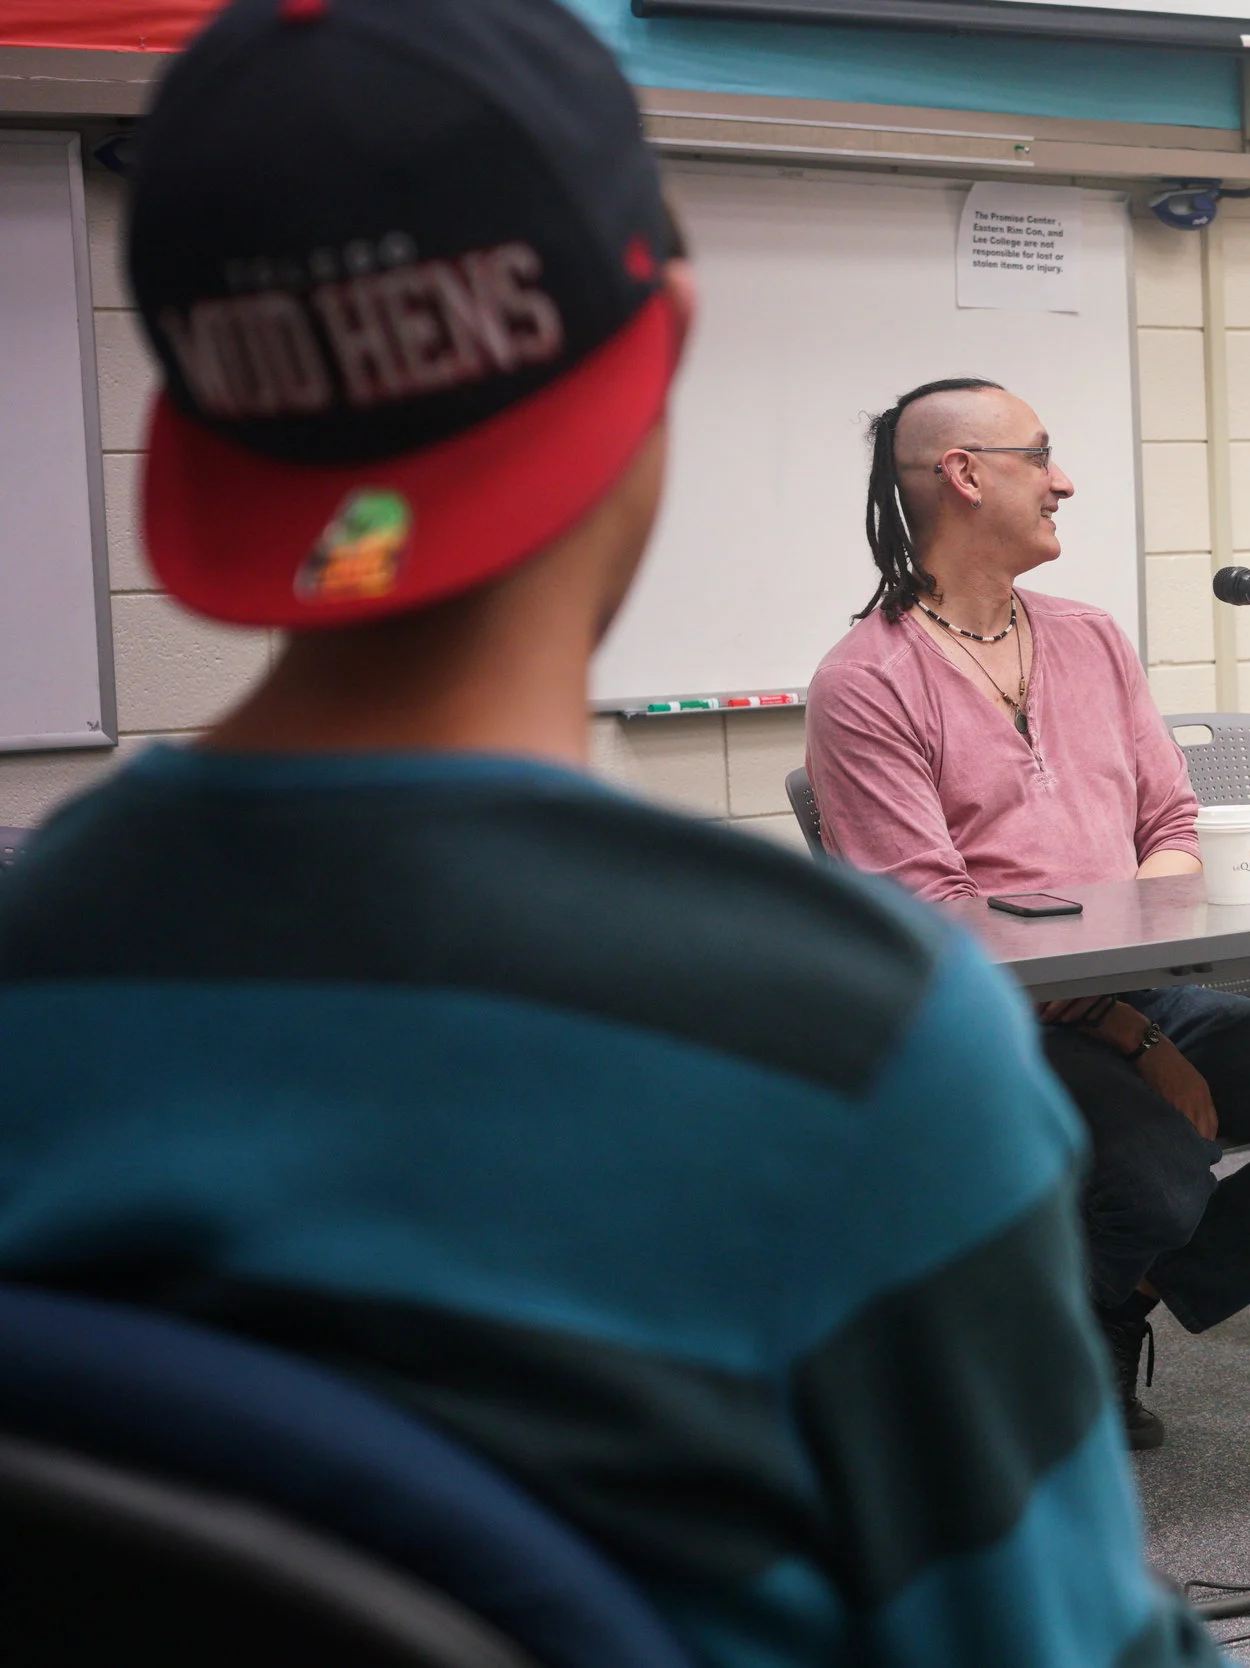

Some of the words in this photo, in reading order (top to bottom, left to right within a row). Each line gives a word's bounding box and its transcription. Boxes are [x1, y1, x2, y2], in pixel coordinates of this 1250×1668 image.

[975, 211, 989, 220] The
[991, 212, 1024, 223] Promise
[1027, 216, 1056, 225] Center
[973, 223, 1005, 233] Eastern
[1007, 226, 1023, 235] Rim
[1025, 228, 1045, 237] Con,
[1047, 230, 1063, 238] and
[973, 235, 987, 244] Lee
[990, 236, 1021, 248] College
[1040, 240, 1055, 248] not
[972, 248, 1020, 258] responsible
[1022, 250, 1035, 259] for
[1036, 252, 1053, 260] lost
[973, 260, 998, 269] stolen
[1000, 261, 1024, 270] items
[1037, 264, 1064, 275] injury.
[311, 241, 564, 409] HENS
